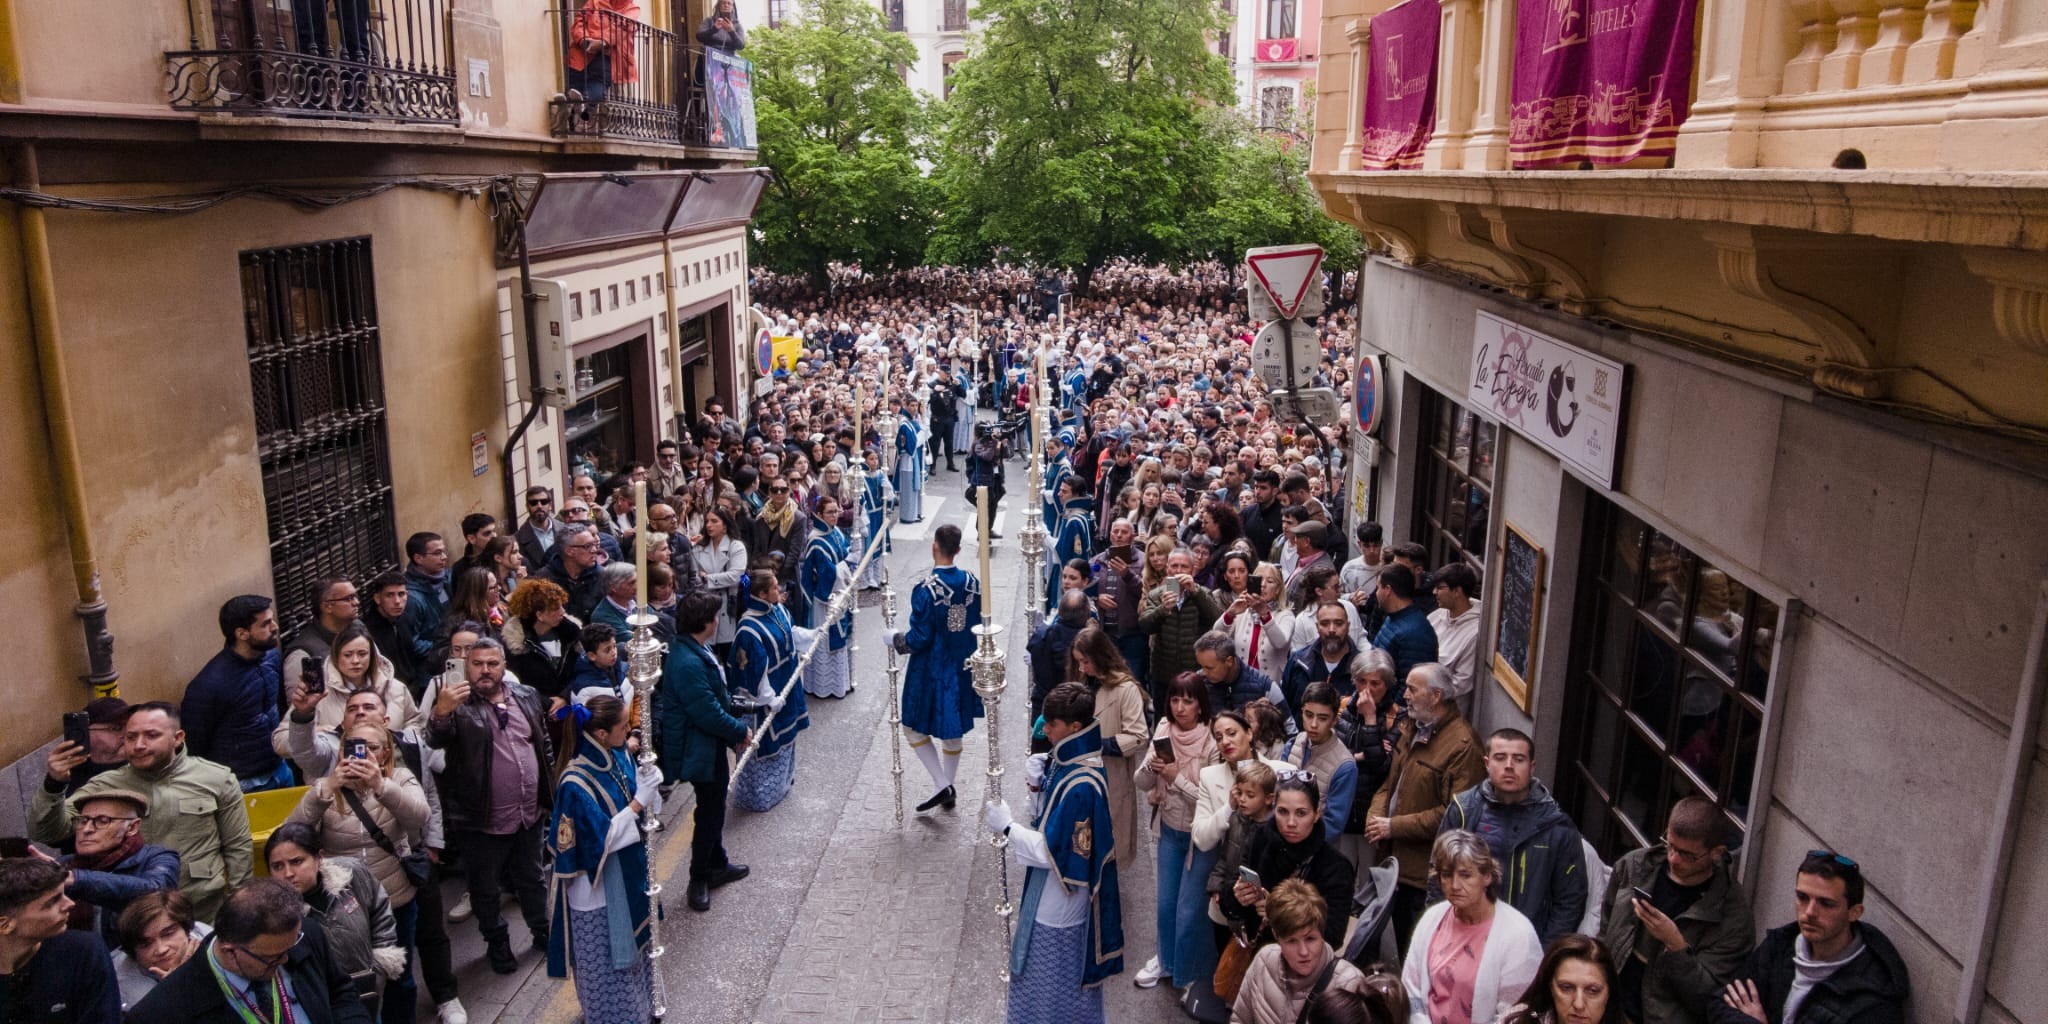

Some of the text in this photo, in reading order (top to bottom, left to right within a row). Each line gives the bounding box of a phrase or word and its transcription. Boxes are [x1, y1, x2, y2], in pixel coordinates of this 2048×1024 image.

[1589, 2, 1638, 37] HOTELES
[1474, 343, 1540, 411] La Espera
